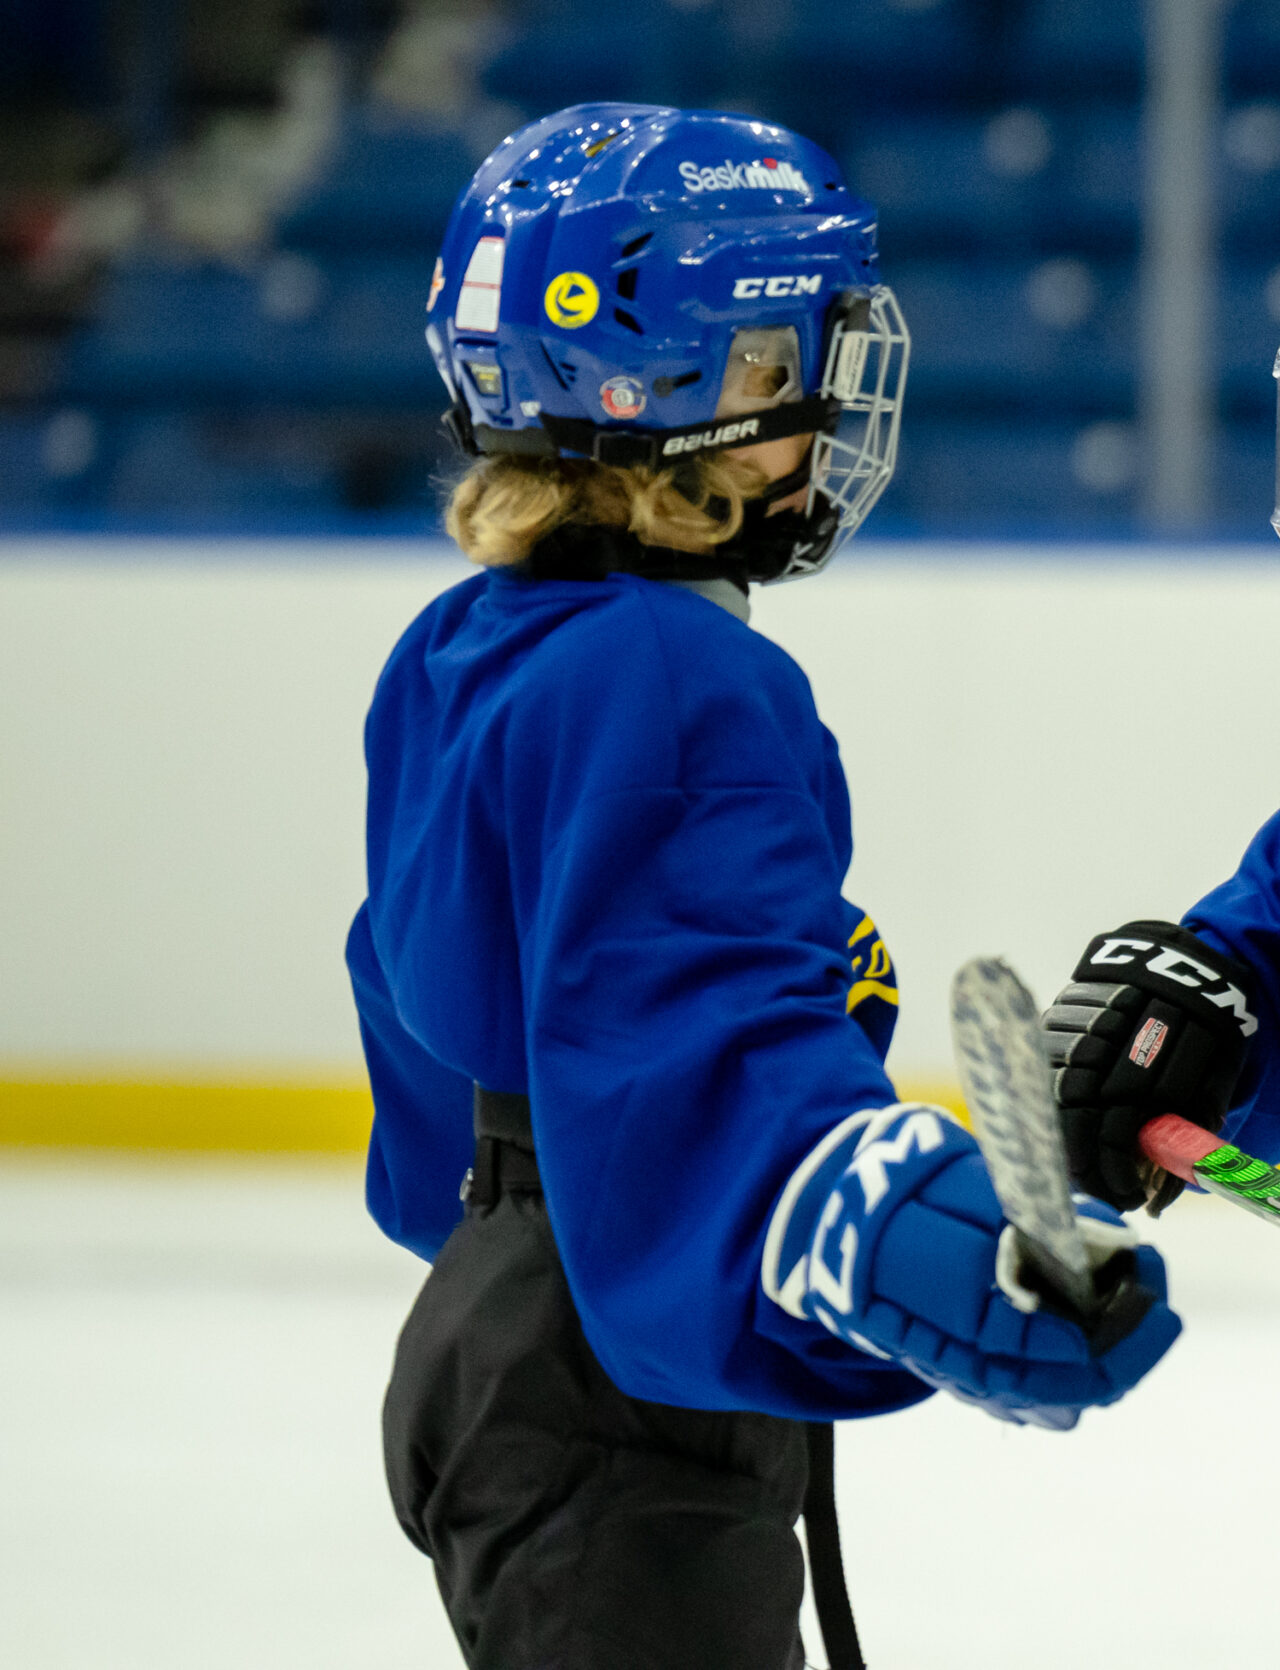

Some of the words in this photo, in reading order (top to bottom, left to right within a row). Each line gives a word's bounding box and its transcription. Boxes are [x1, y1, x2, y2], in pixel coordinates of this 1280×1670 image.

[678, 158, 809, 193] Saskmilk
[733, 274, 822, 299] CCM
[663, 419, 760, 456] BAUER
[1090, 938, 1259, 1038] CCM
